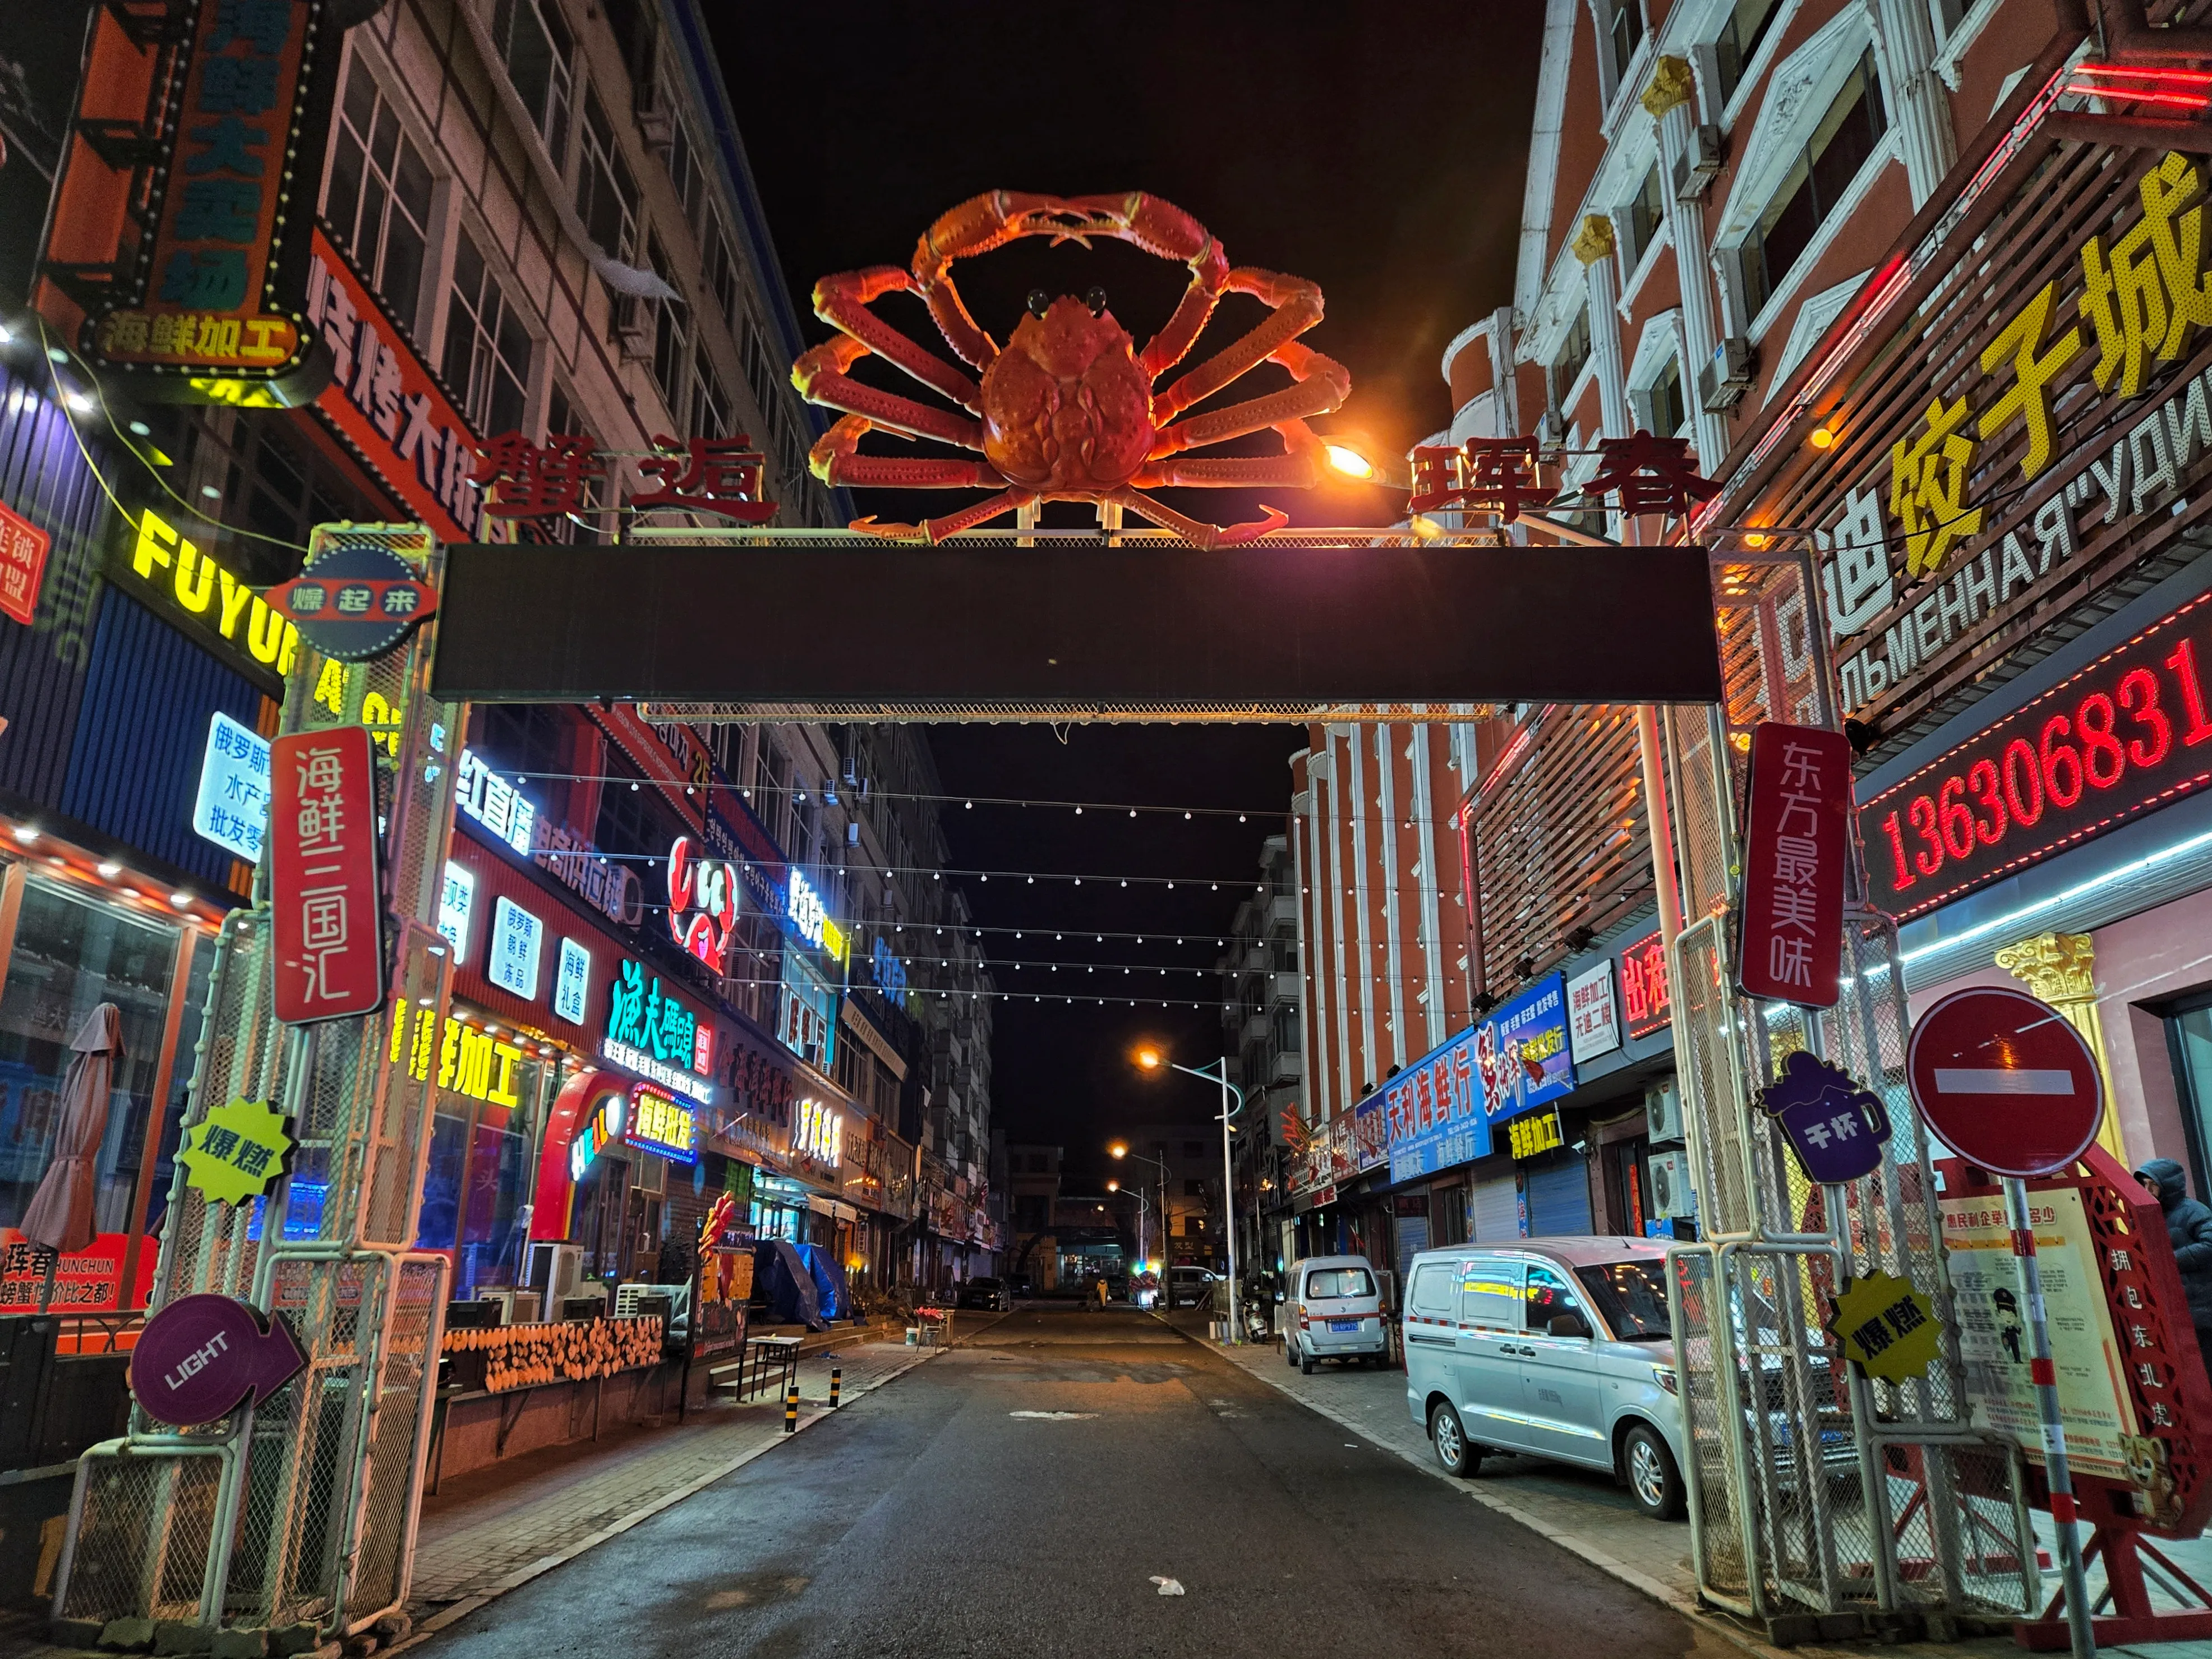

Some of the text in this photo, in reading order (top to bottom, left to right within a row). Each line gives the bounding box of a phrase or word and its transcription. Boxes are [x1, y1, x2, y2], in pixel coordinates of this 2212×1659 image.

[96, 310, 287, 360] 海鲜加工
[1407, 428, 1725, 525] 珲春
[292, 586, 417, 612] 爆起来
[1840, 491, 2074, 715] ЛЬМЕННАЯ
[215, 722, 271, 777] 俄罗斯
[208, 802, 265, 854] 批发零
[284, 747, 351, 1003] 海鲜三国汇
[1769, 741, 1823, 987] 东方最美味
[560, 985, 582, 1017] 礼盒
[1572, 975, 1609, 1014] 海鲜加工
[1388, 1045, 1472, 1148] 天利海鲜行
[197, 1123, 275, 1178] 爆燃
[1509, 1113, 1564, 1160] 海鲜加工
[1805, 1111, 1860, 1151] 干杯
[1946, 1205, 2056, 1228] 惠民利企举多少
[3, 1243, 52, 1277] 珲春
[1851, 1295, 1928, 1361] 爆燃
[164, 1330, 230, 1391] LIGHT
